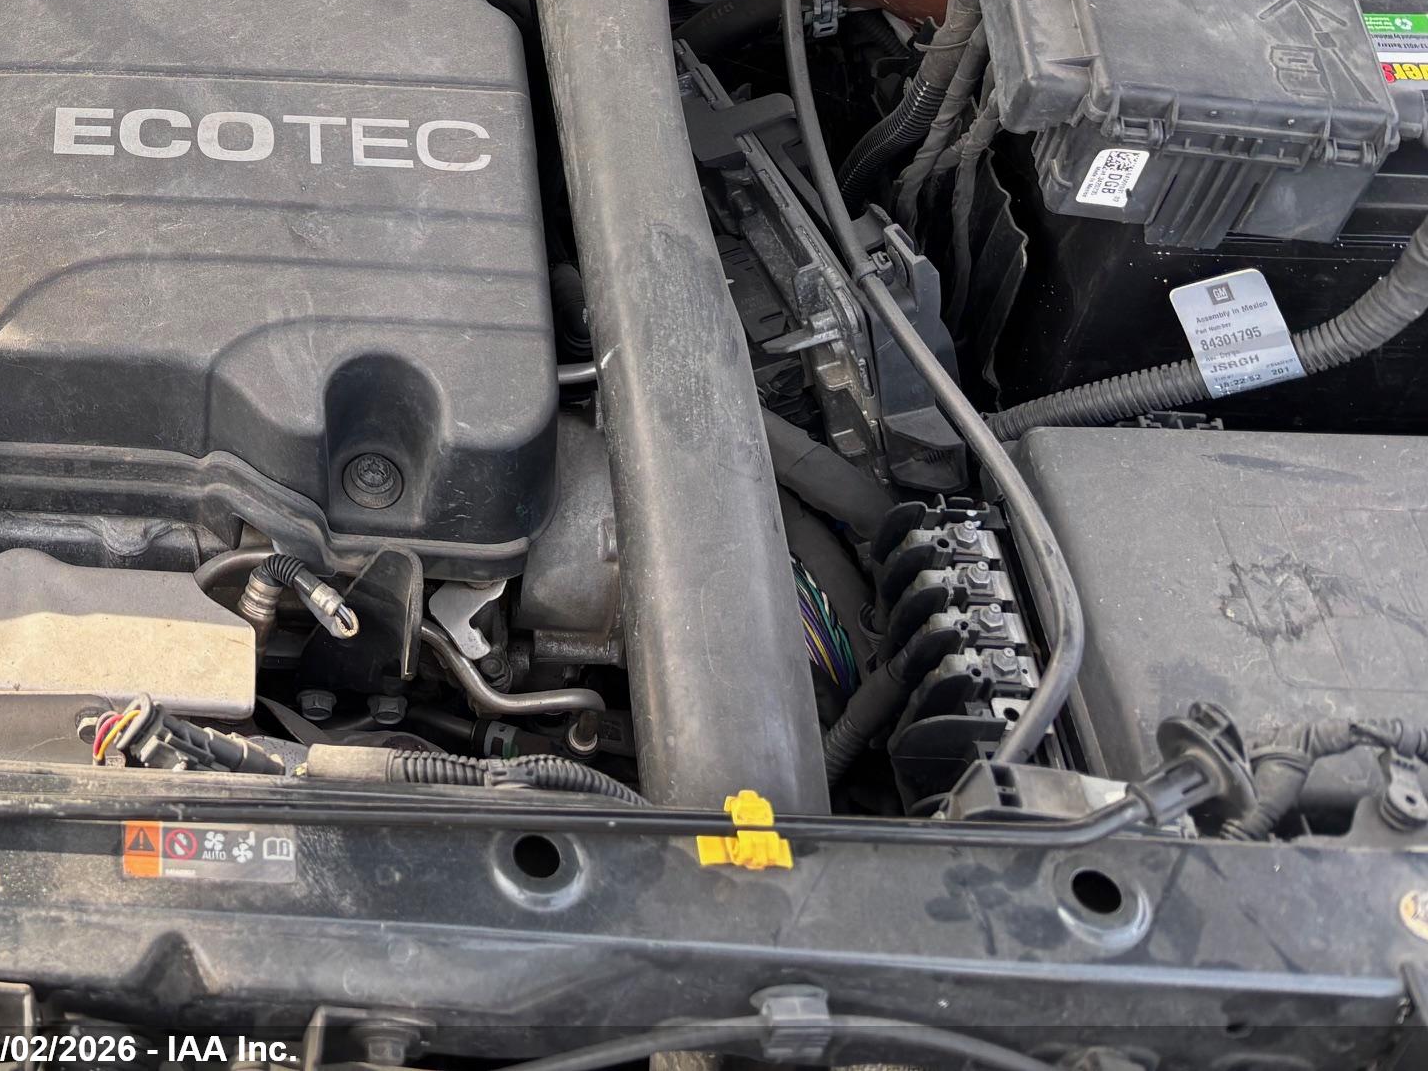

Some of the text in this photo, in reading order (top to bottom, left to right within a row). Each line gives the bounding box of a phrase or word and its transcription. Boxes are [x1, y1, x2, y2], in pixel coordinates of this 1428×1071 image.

[53, 106, 492, 172] ECOTEC
[1101, 173, 1123, 194] DGB
[1212, 285, 1229, 300] GM
[1195, 310, 1231, 324] Assembly
[1241, 300, 1269, 313] Mexico
[1200, 326, 1262, 351] 84301795
[201, 850, 227, 861] AUTO
